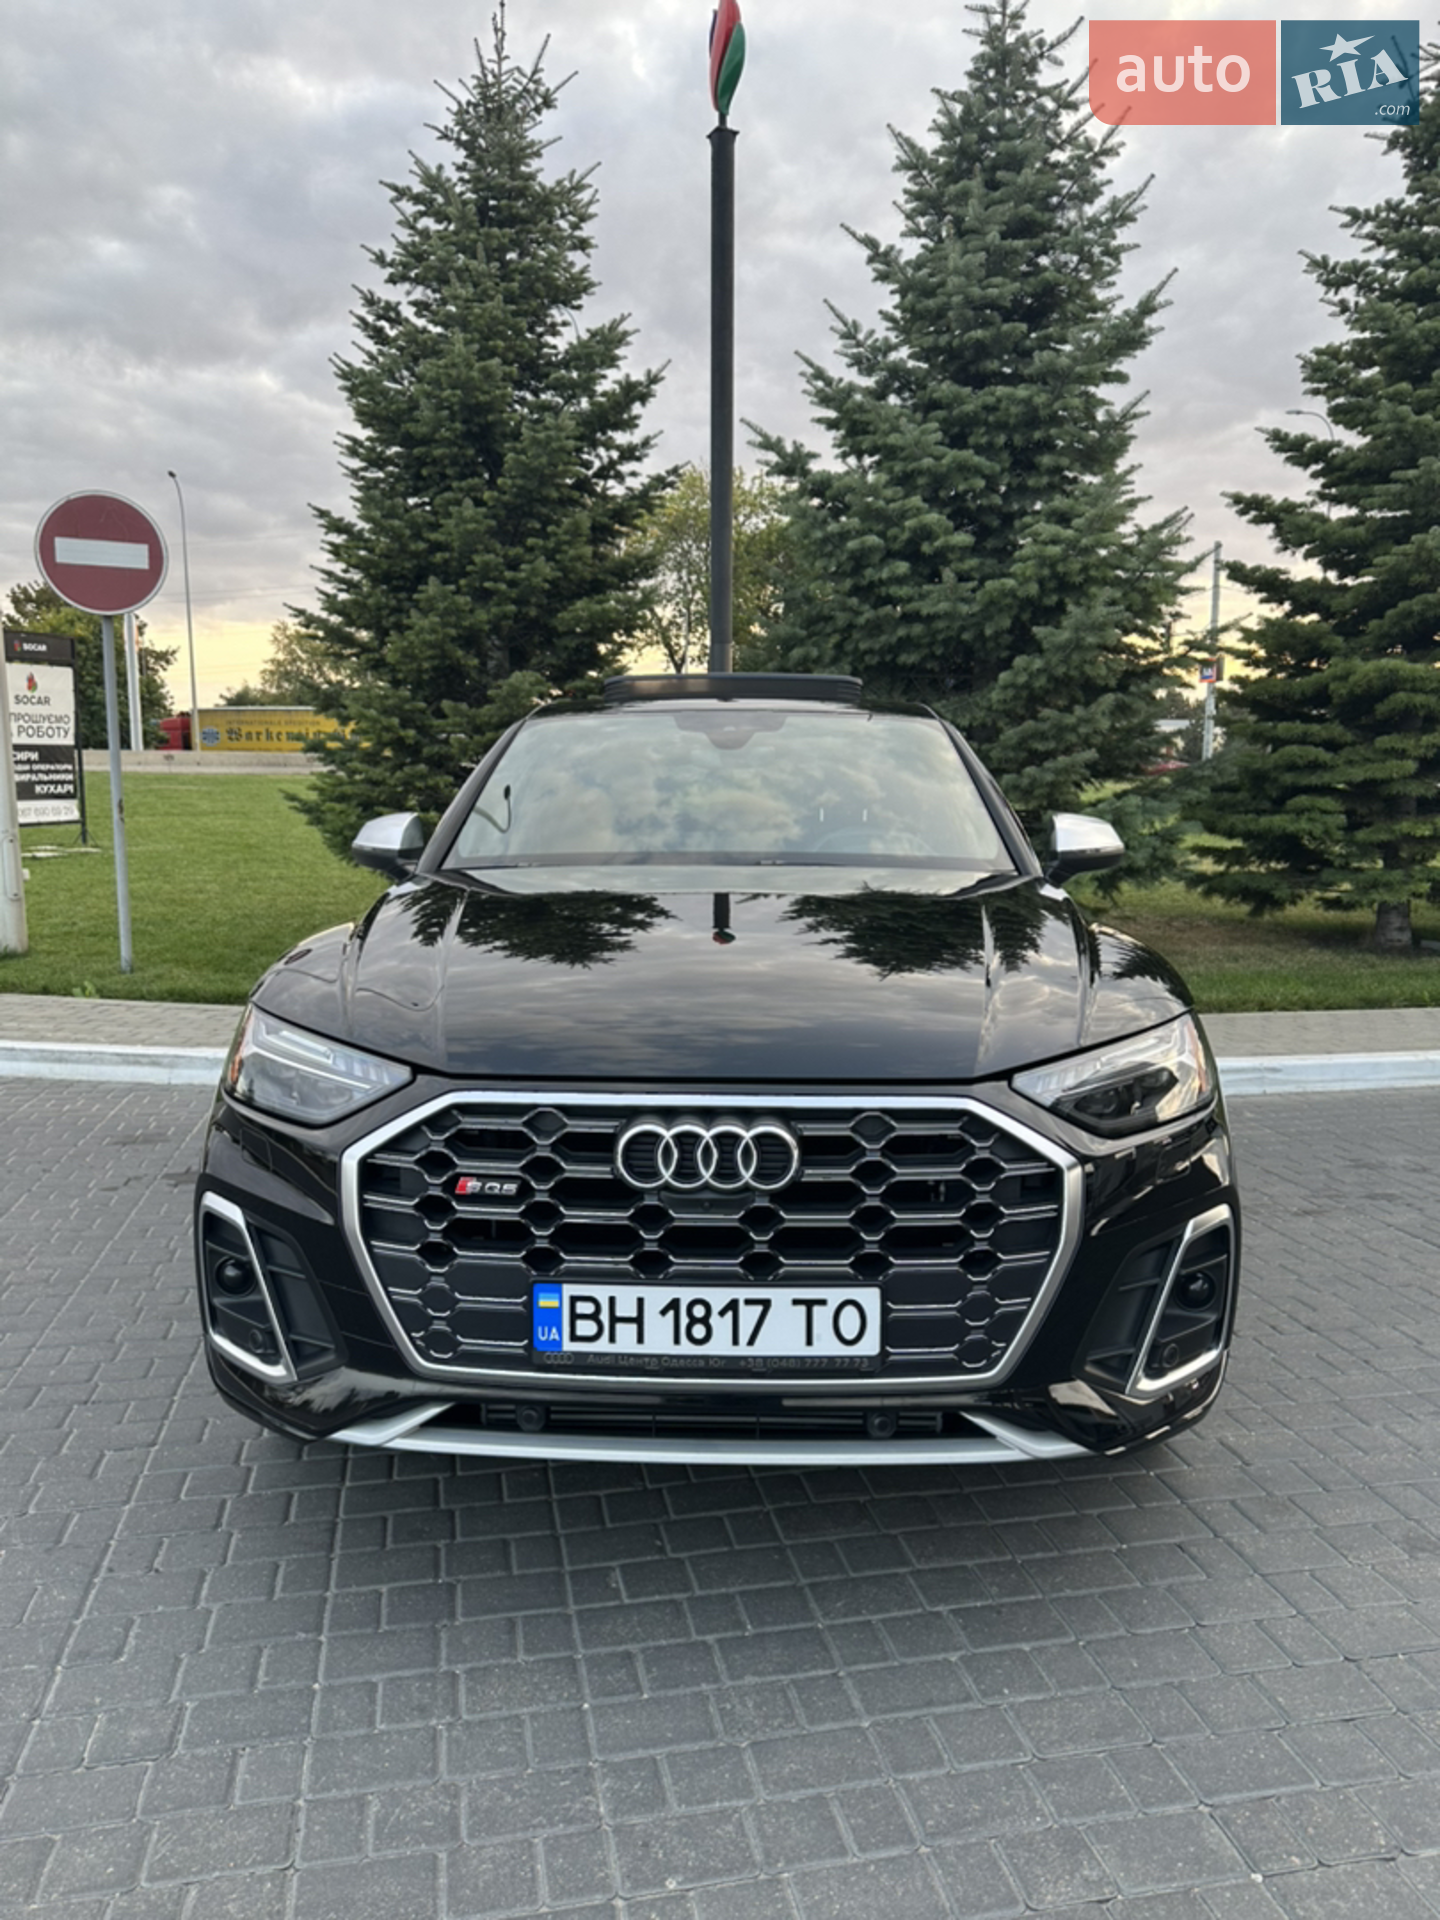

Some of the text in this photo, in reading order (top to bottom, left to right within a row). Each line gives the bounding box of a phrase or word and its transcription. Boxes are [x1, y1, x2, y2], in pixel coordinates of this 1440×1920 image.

[22, 642, 47, 652] SOCAR
[14, 694, 51, 706] SOCAR
[17, 725, 71, 739] РОБОТУ
[34, 783, 75, 795] КУХАРІ
[465, 1180, 518, 1196] SQ5
[568, 1294, 868, 1347] BH 1817 TO
[537, 1326, 561, 1342] UA
[587, 1354, 615, 1365] Audi
[618, 1354, 659, 1368] Центр
[661, 1356, 705, 1368] Одесса
